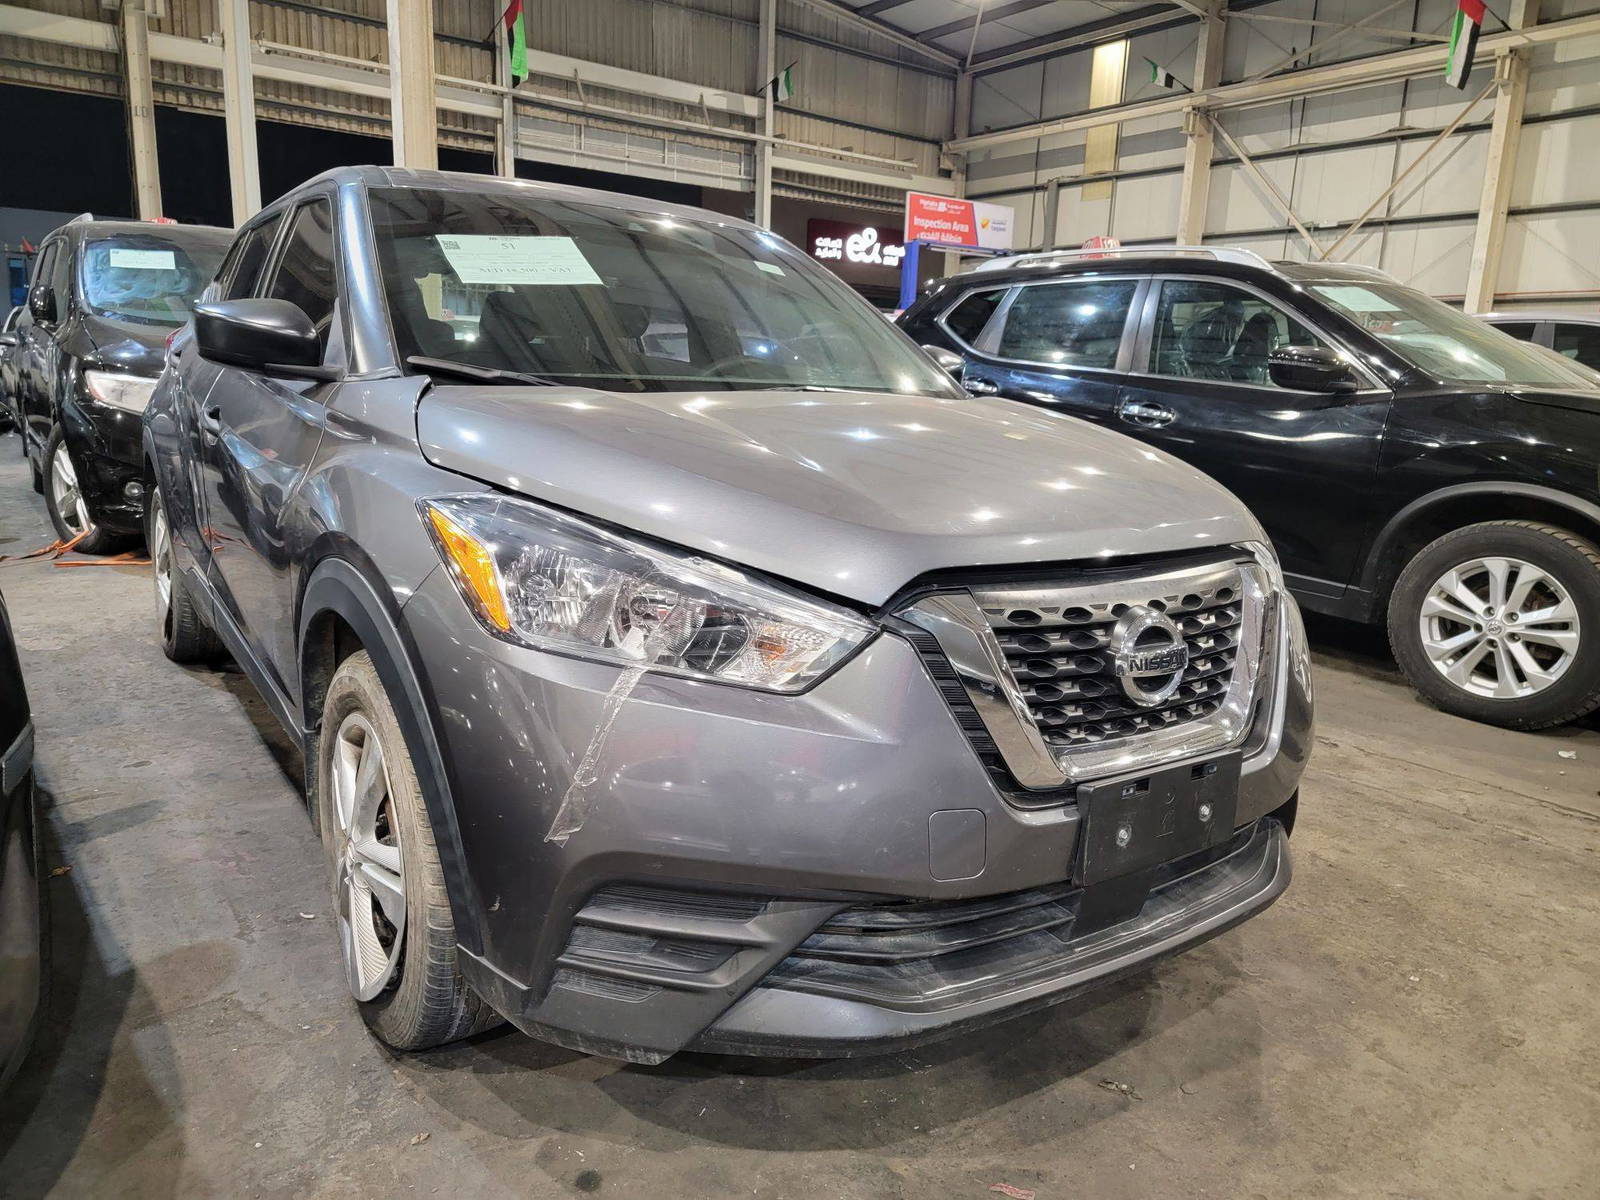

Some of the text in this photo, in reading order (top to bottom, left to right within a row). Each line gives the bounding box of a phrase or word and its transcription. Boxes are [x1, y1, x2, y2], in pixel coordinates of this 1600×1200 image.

[914, 216, 969, 232] Inspection Area
[1128, 647, 1187, 673] NISSAN
